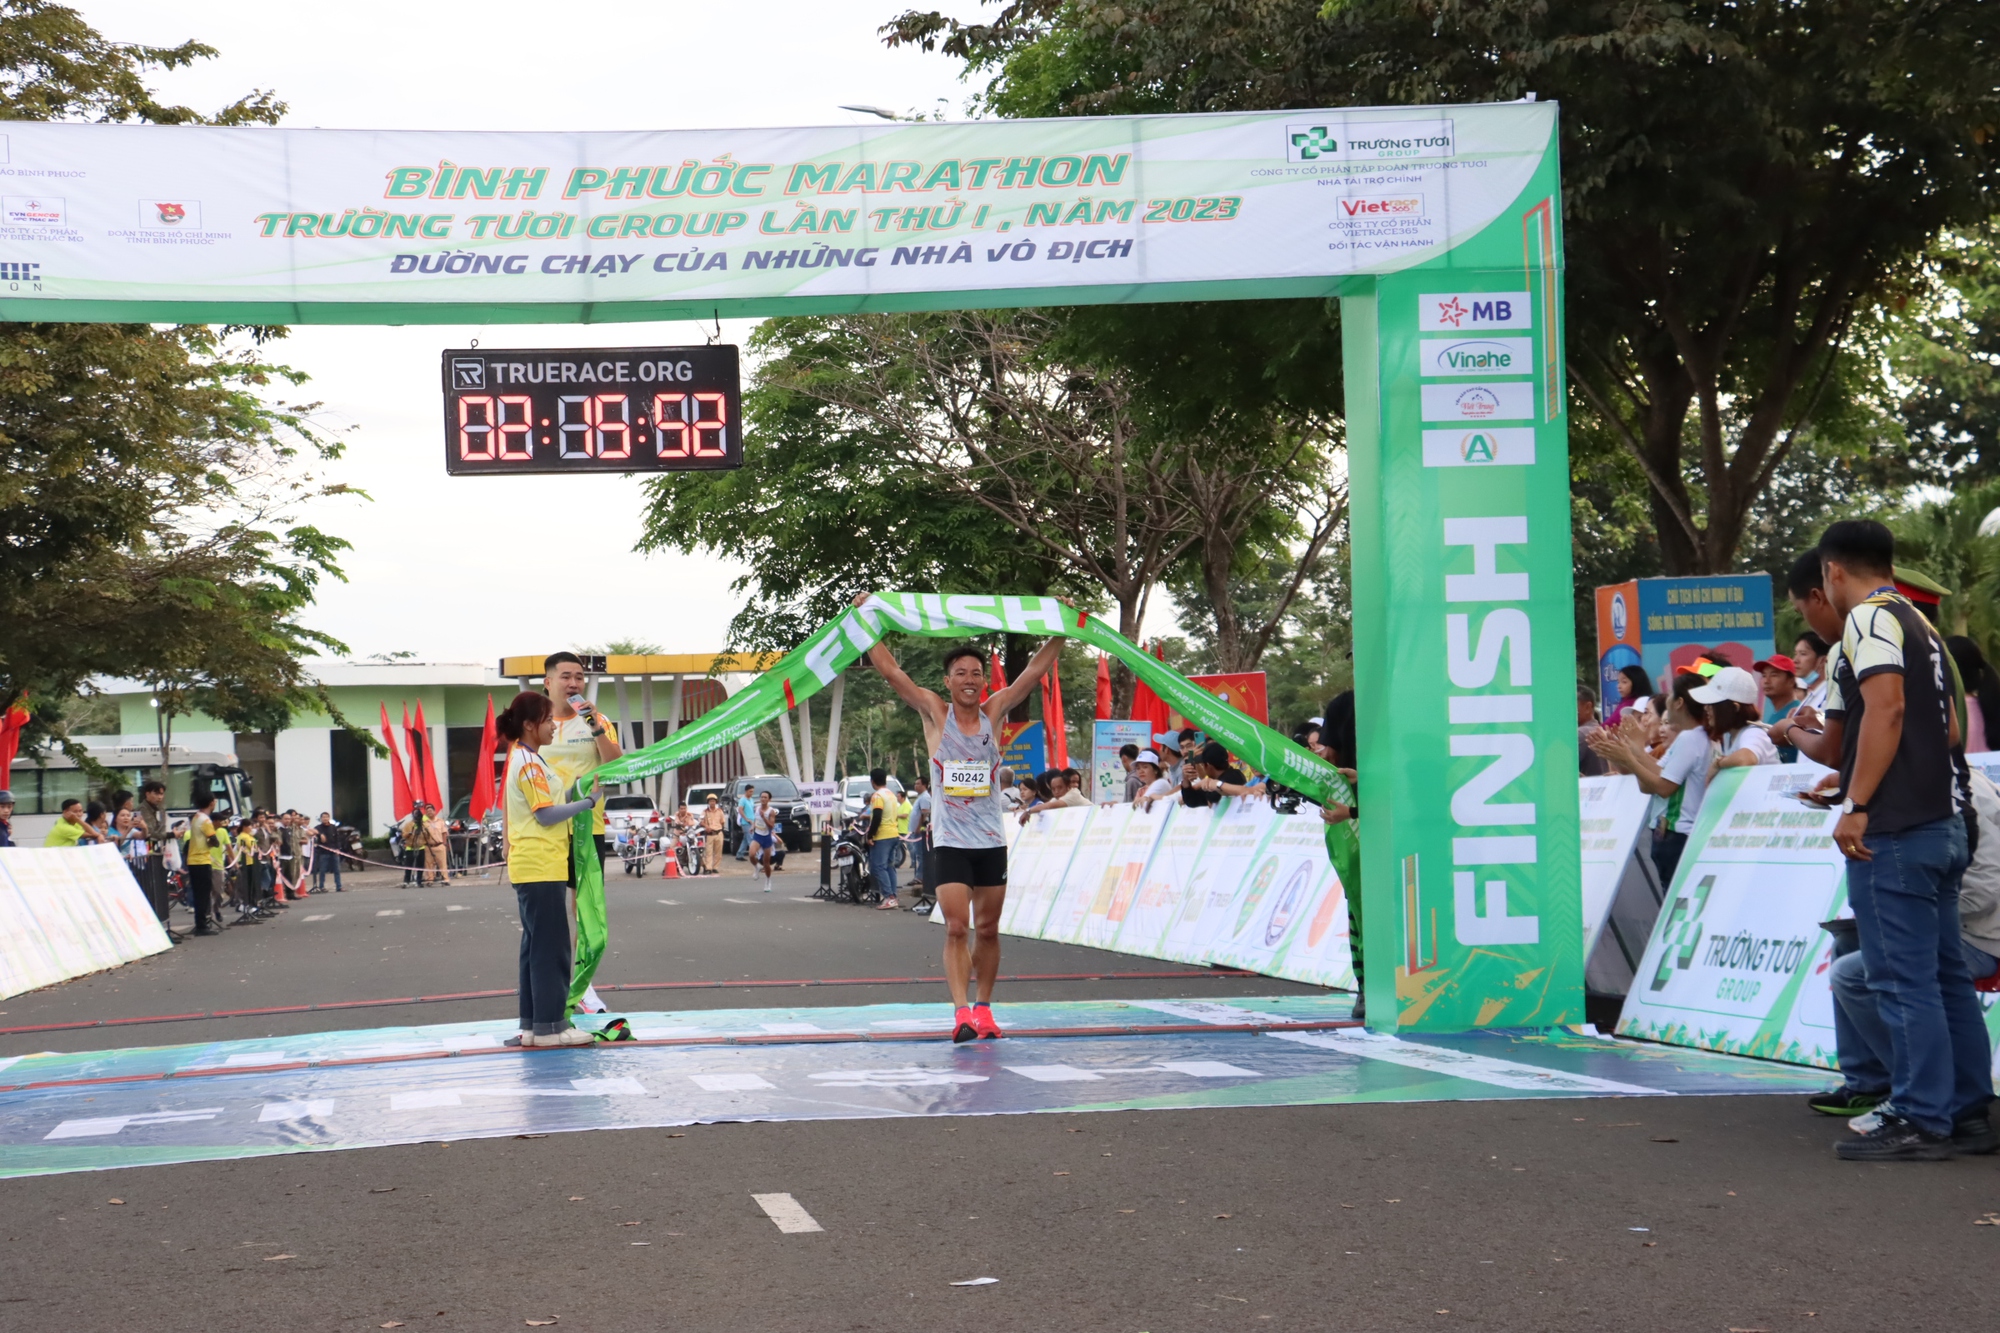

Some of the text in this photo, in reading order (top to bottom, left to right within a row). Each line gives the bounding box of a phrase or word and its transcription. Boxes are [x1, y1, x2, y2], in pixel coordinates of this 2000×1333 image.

[1348, 136, 1450, 150] TRƯỜNG TƯƠI
[1378, 149, 1420, 157] GROUP
[384, 153, 1132, 200] BÌNH PHƯỚC MARATHON
[254, 206, 455, 239] TRƯỜNG
[464, 210, 579, 239] TƯƠI
[586, 212, 749, 239] GROUP
[758, 200, 860, 235] LẦN
[867, 195, 967, 232] THỨ
[1023, 196, 1138, 227] NĂM
[1142, 195, 1244, 223] 2023
[1343, 227, 1418, 237] VIETRACE365
[389, 238, 1134, 278] ĐƯỜNG CHẠY CỦA NHỮNG NHÀ VÔ ĐỊCH
[1472, 300, 1512, 322] MB
[1447, 351, 1511, 368] Vinahe
[491, 361, 693, 384] TRUERACE.ORG
[458, 392, 727, 461] 02:15:52
[804, 590, 1066, 688] FINISH
[1443, 515, 1539, 947] FINISH
[951, 773, 984, 782] 50242
[1703, 929, 1808, 975] TRƯỜNG TƯƠI
[1716, 977, 1761, 1002] GROUP
